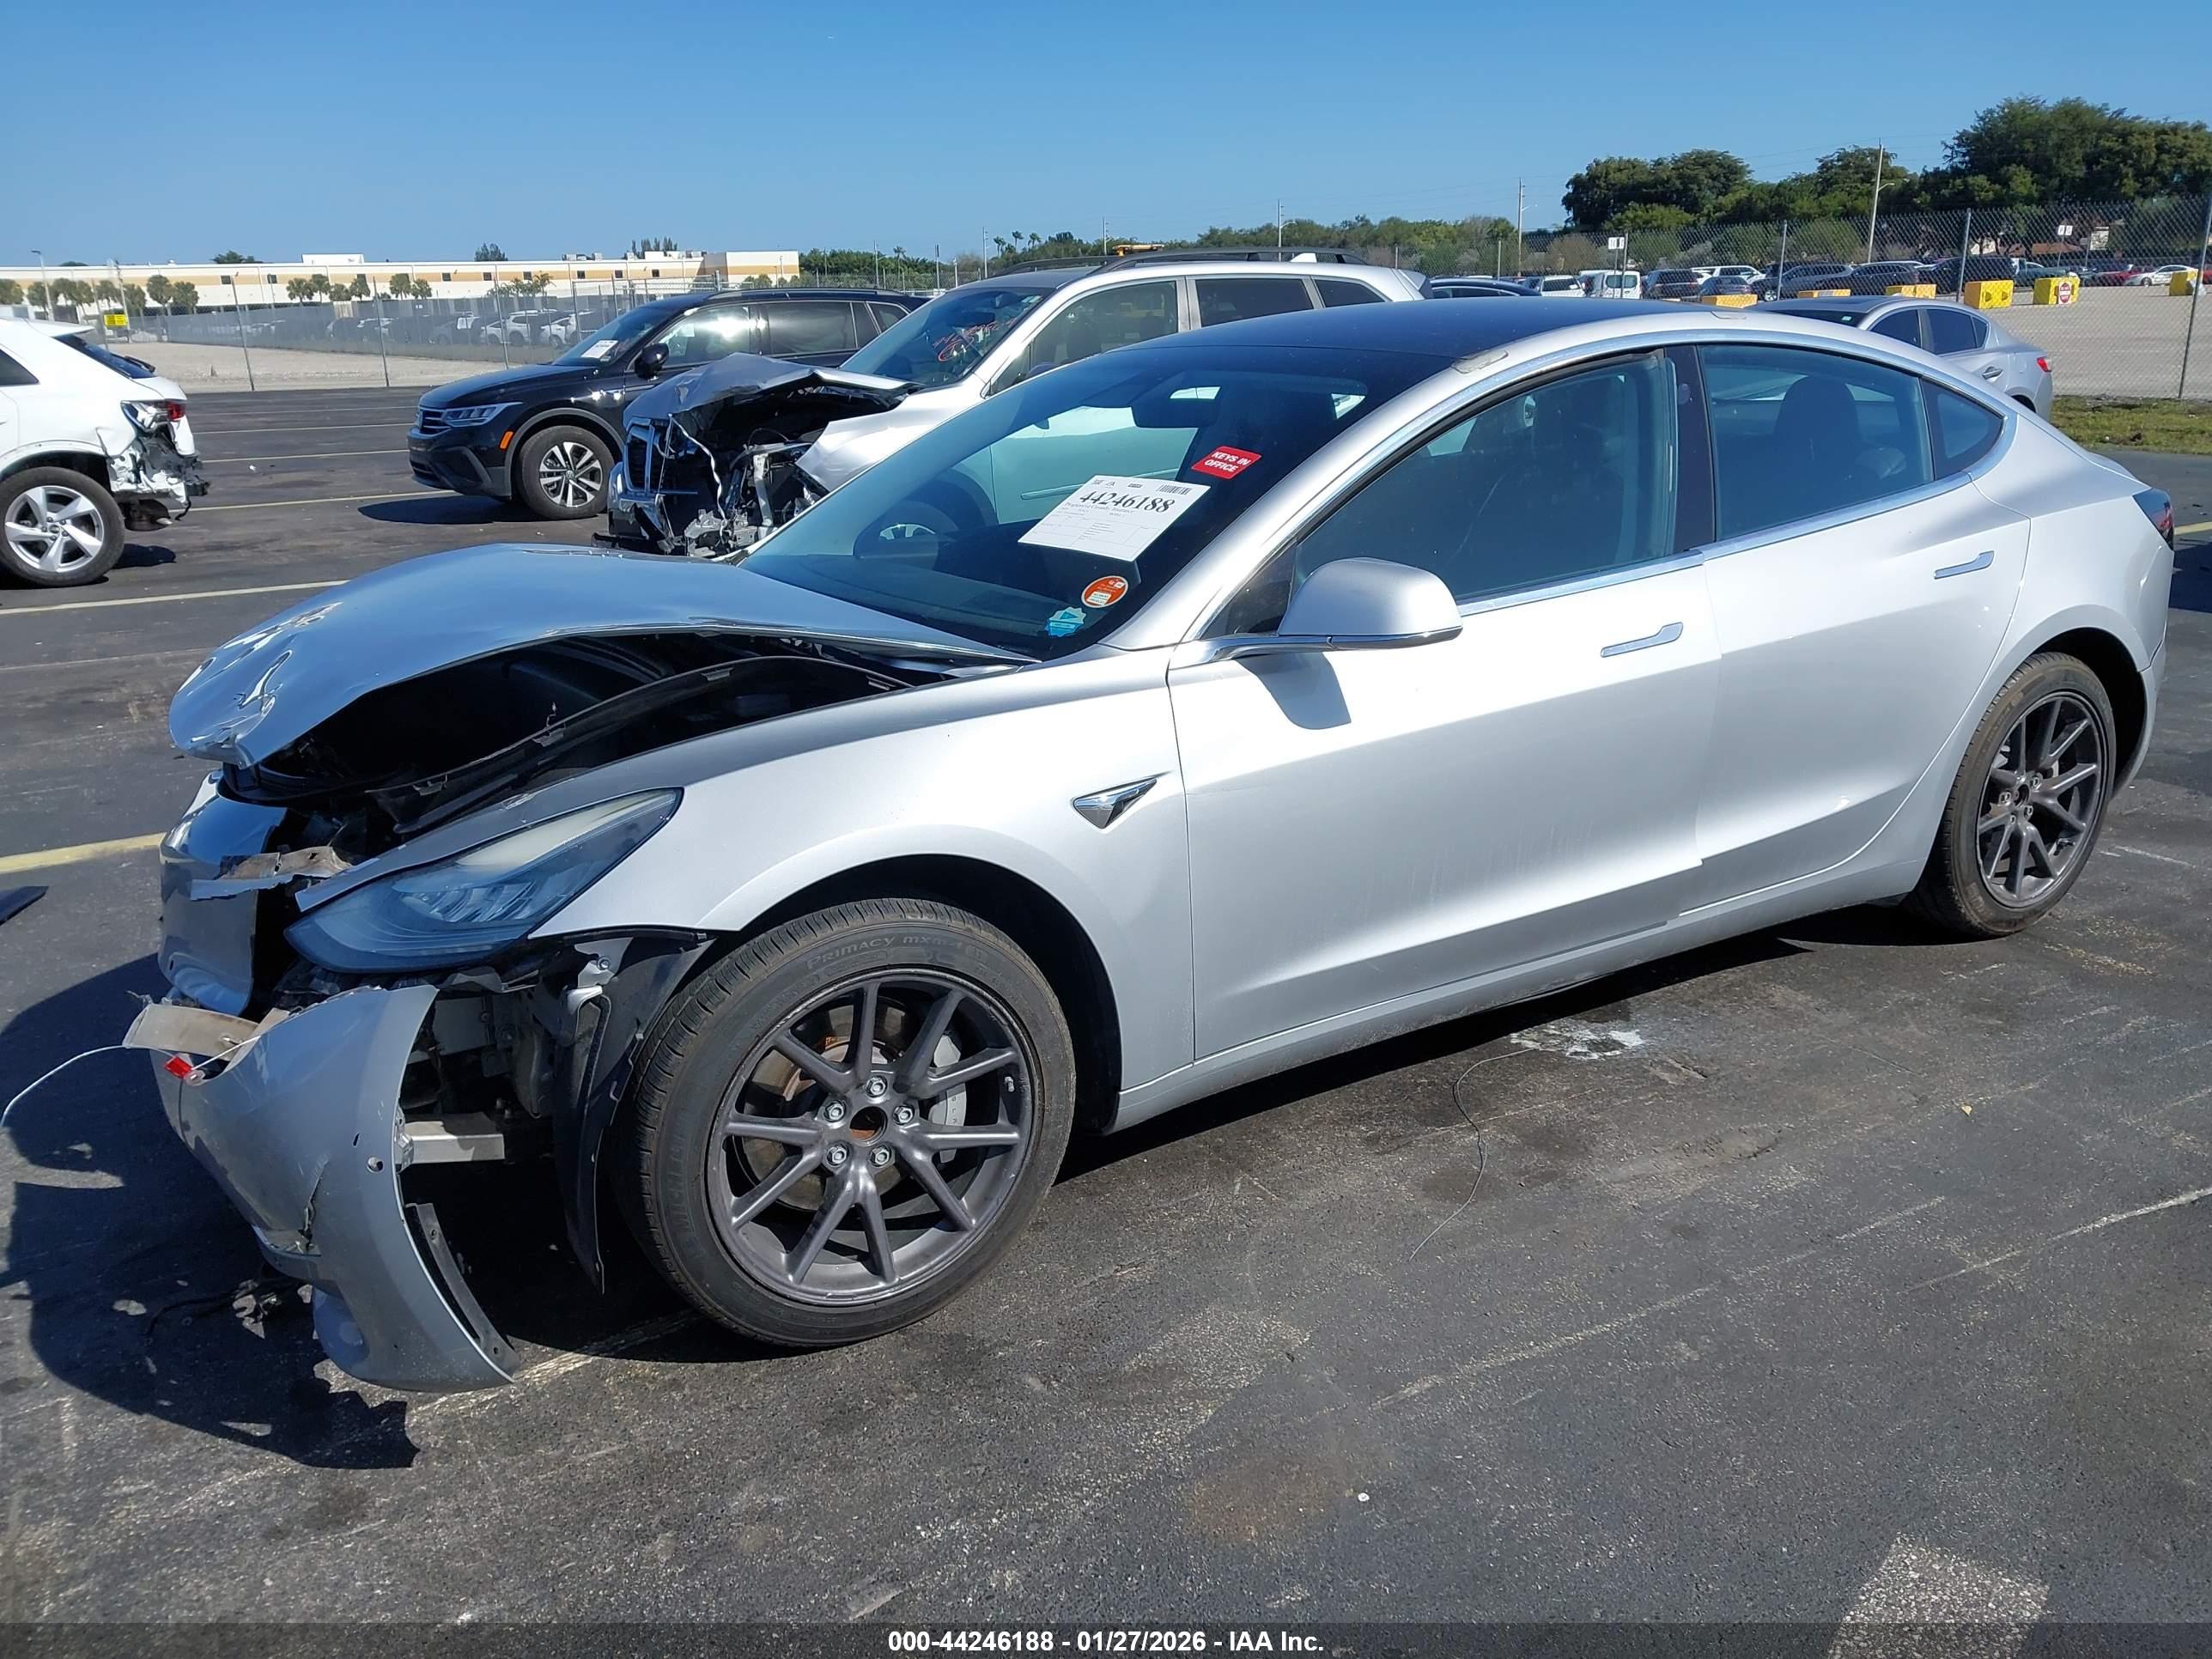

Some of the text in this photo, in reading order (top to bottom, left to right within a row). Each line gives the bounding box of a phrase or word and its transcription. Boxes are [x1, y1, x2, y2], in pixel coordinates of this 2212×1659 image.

[1205, 459, 1238, 471] OFFICE
[1212, 452, 1238, 462] KEYS
[1079, 491, 1176, 513] 44246188
[806, 937, 896, 970] PRIMACY
